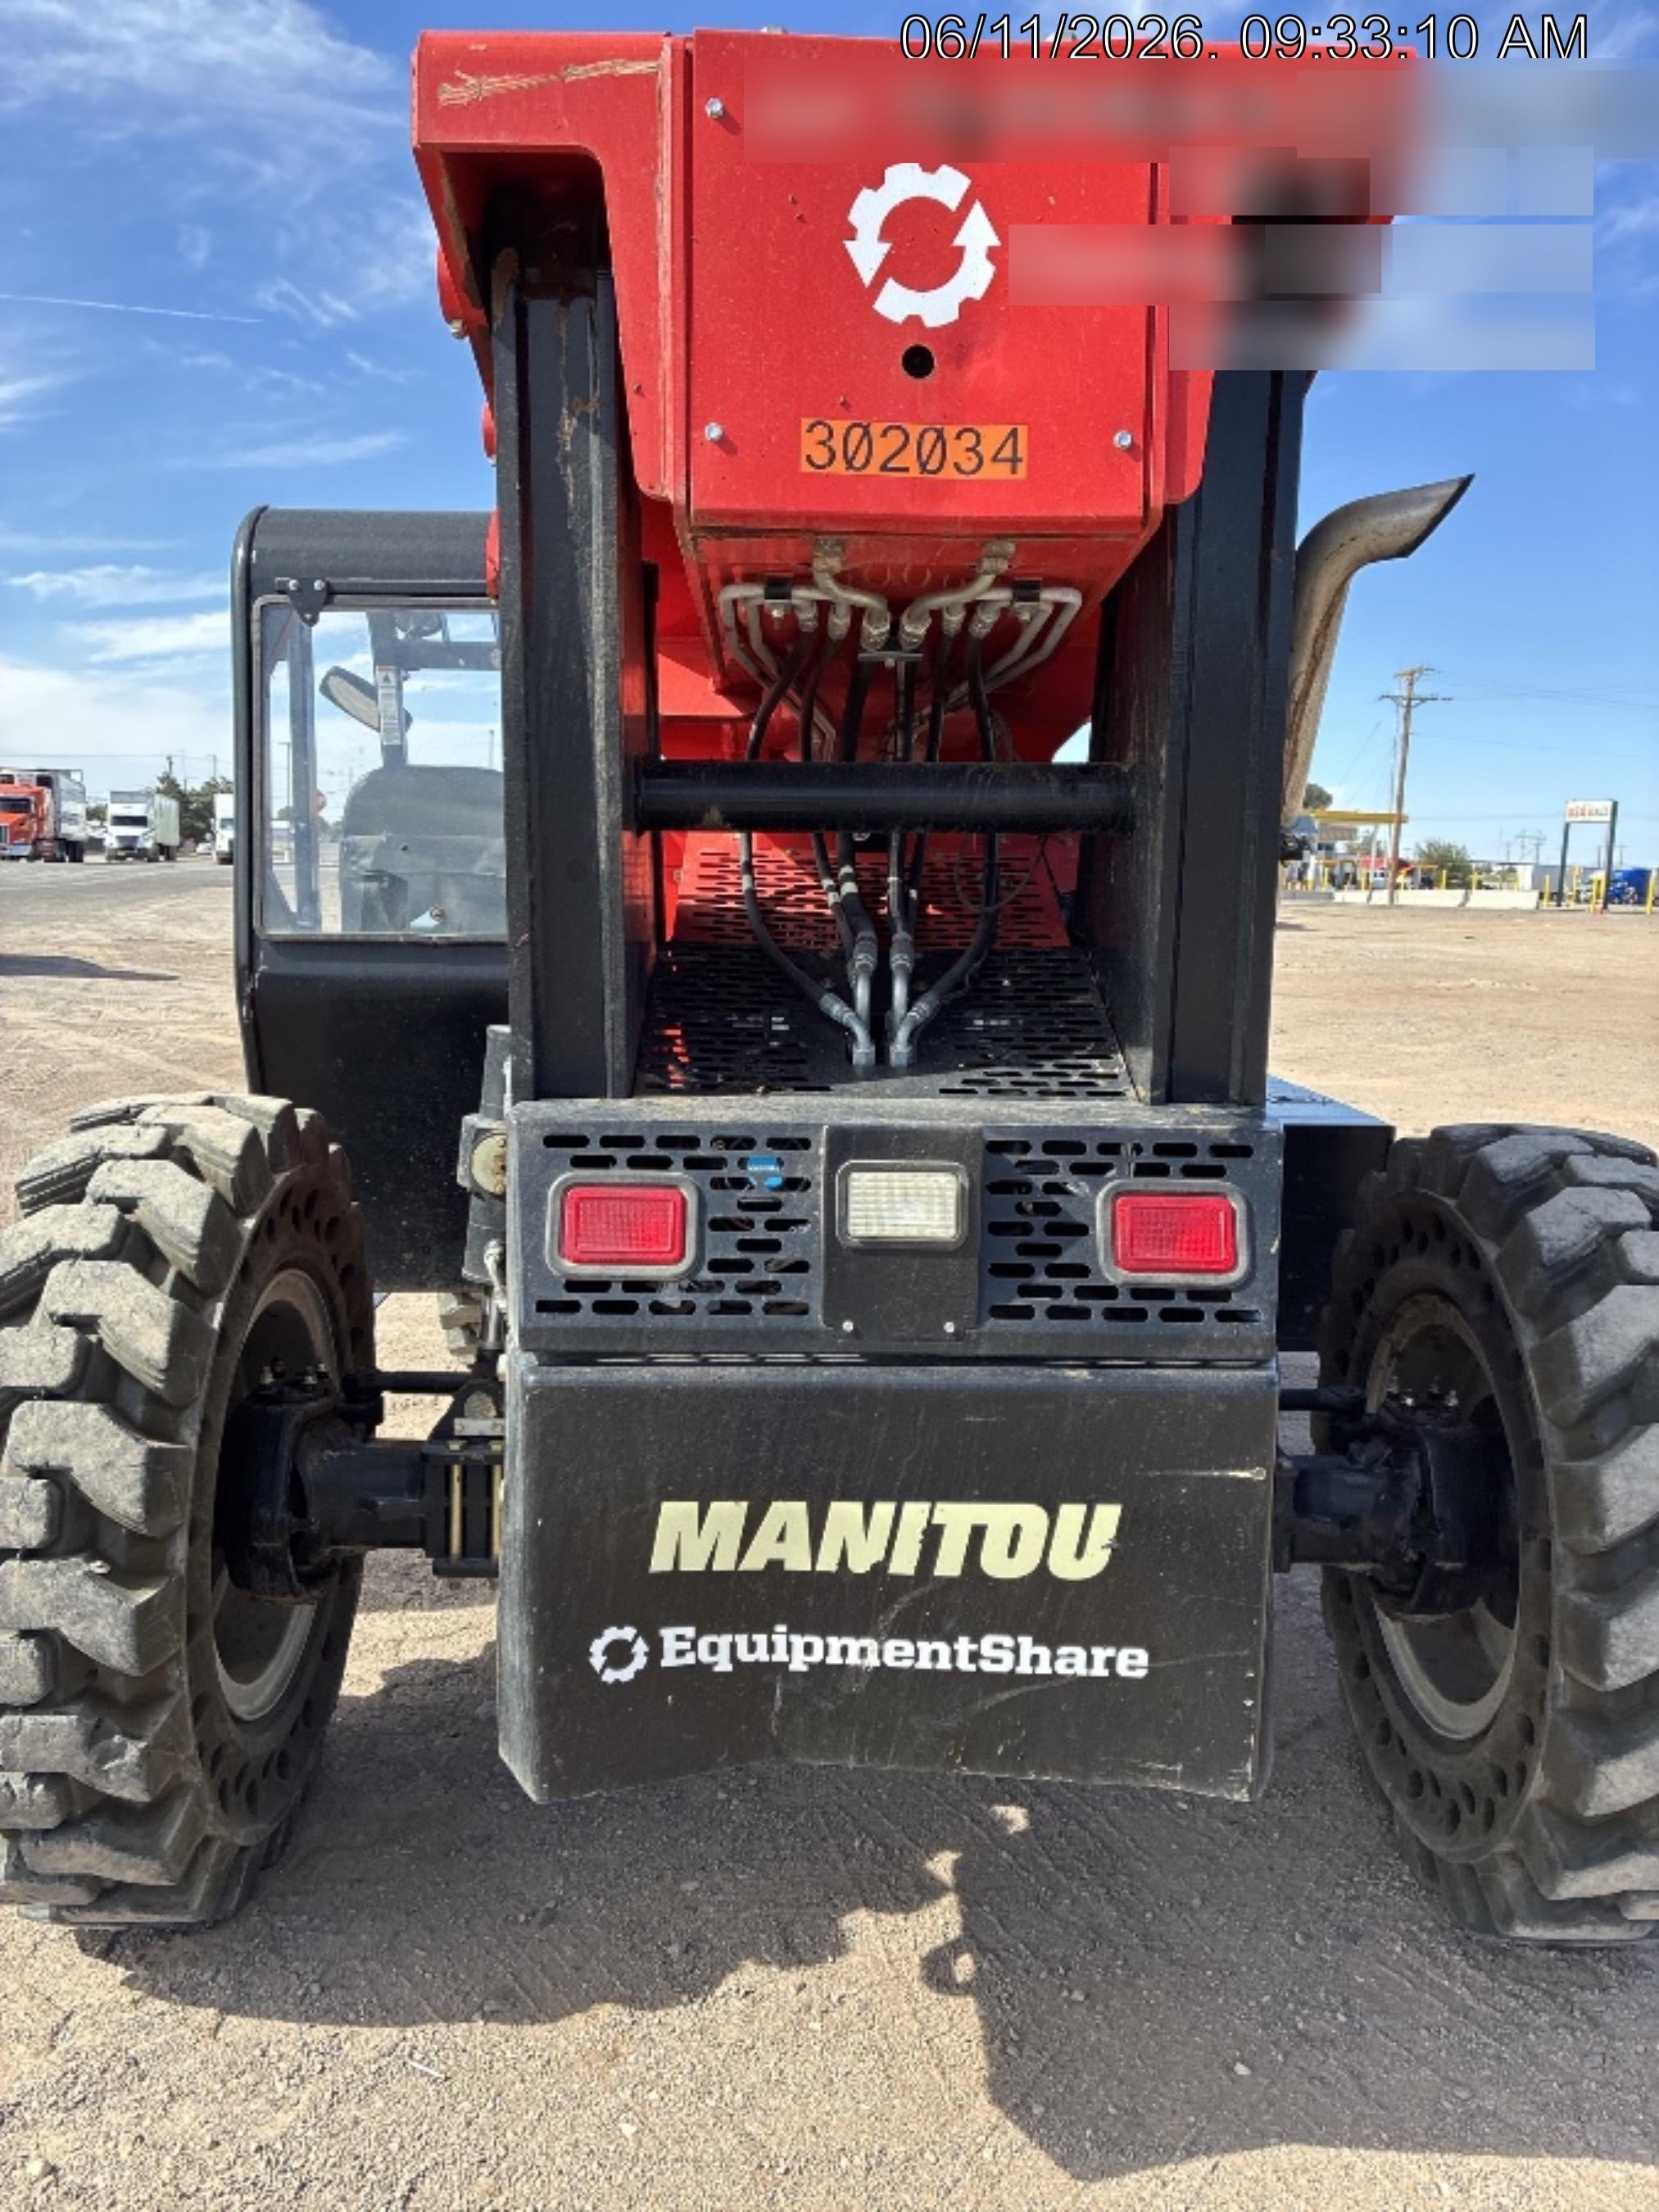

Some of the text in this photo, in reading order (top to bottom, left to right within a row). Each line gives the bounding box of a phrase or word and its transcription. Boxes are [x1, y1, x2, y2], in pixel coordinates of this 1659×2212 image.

[805, 419, 1023, 475] 302034
[648, 1500, 1122, 1580] MANITOU
[660, 1624, 1150, 1679] EquipmentShare
